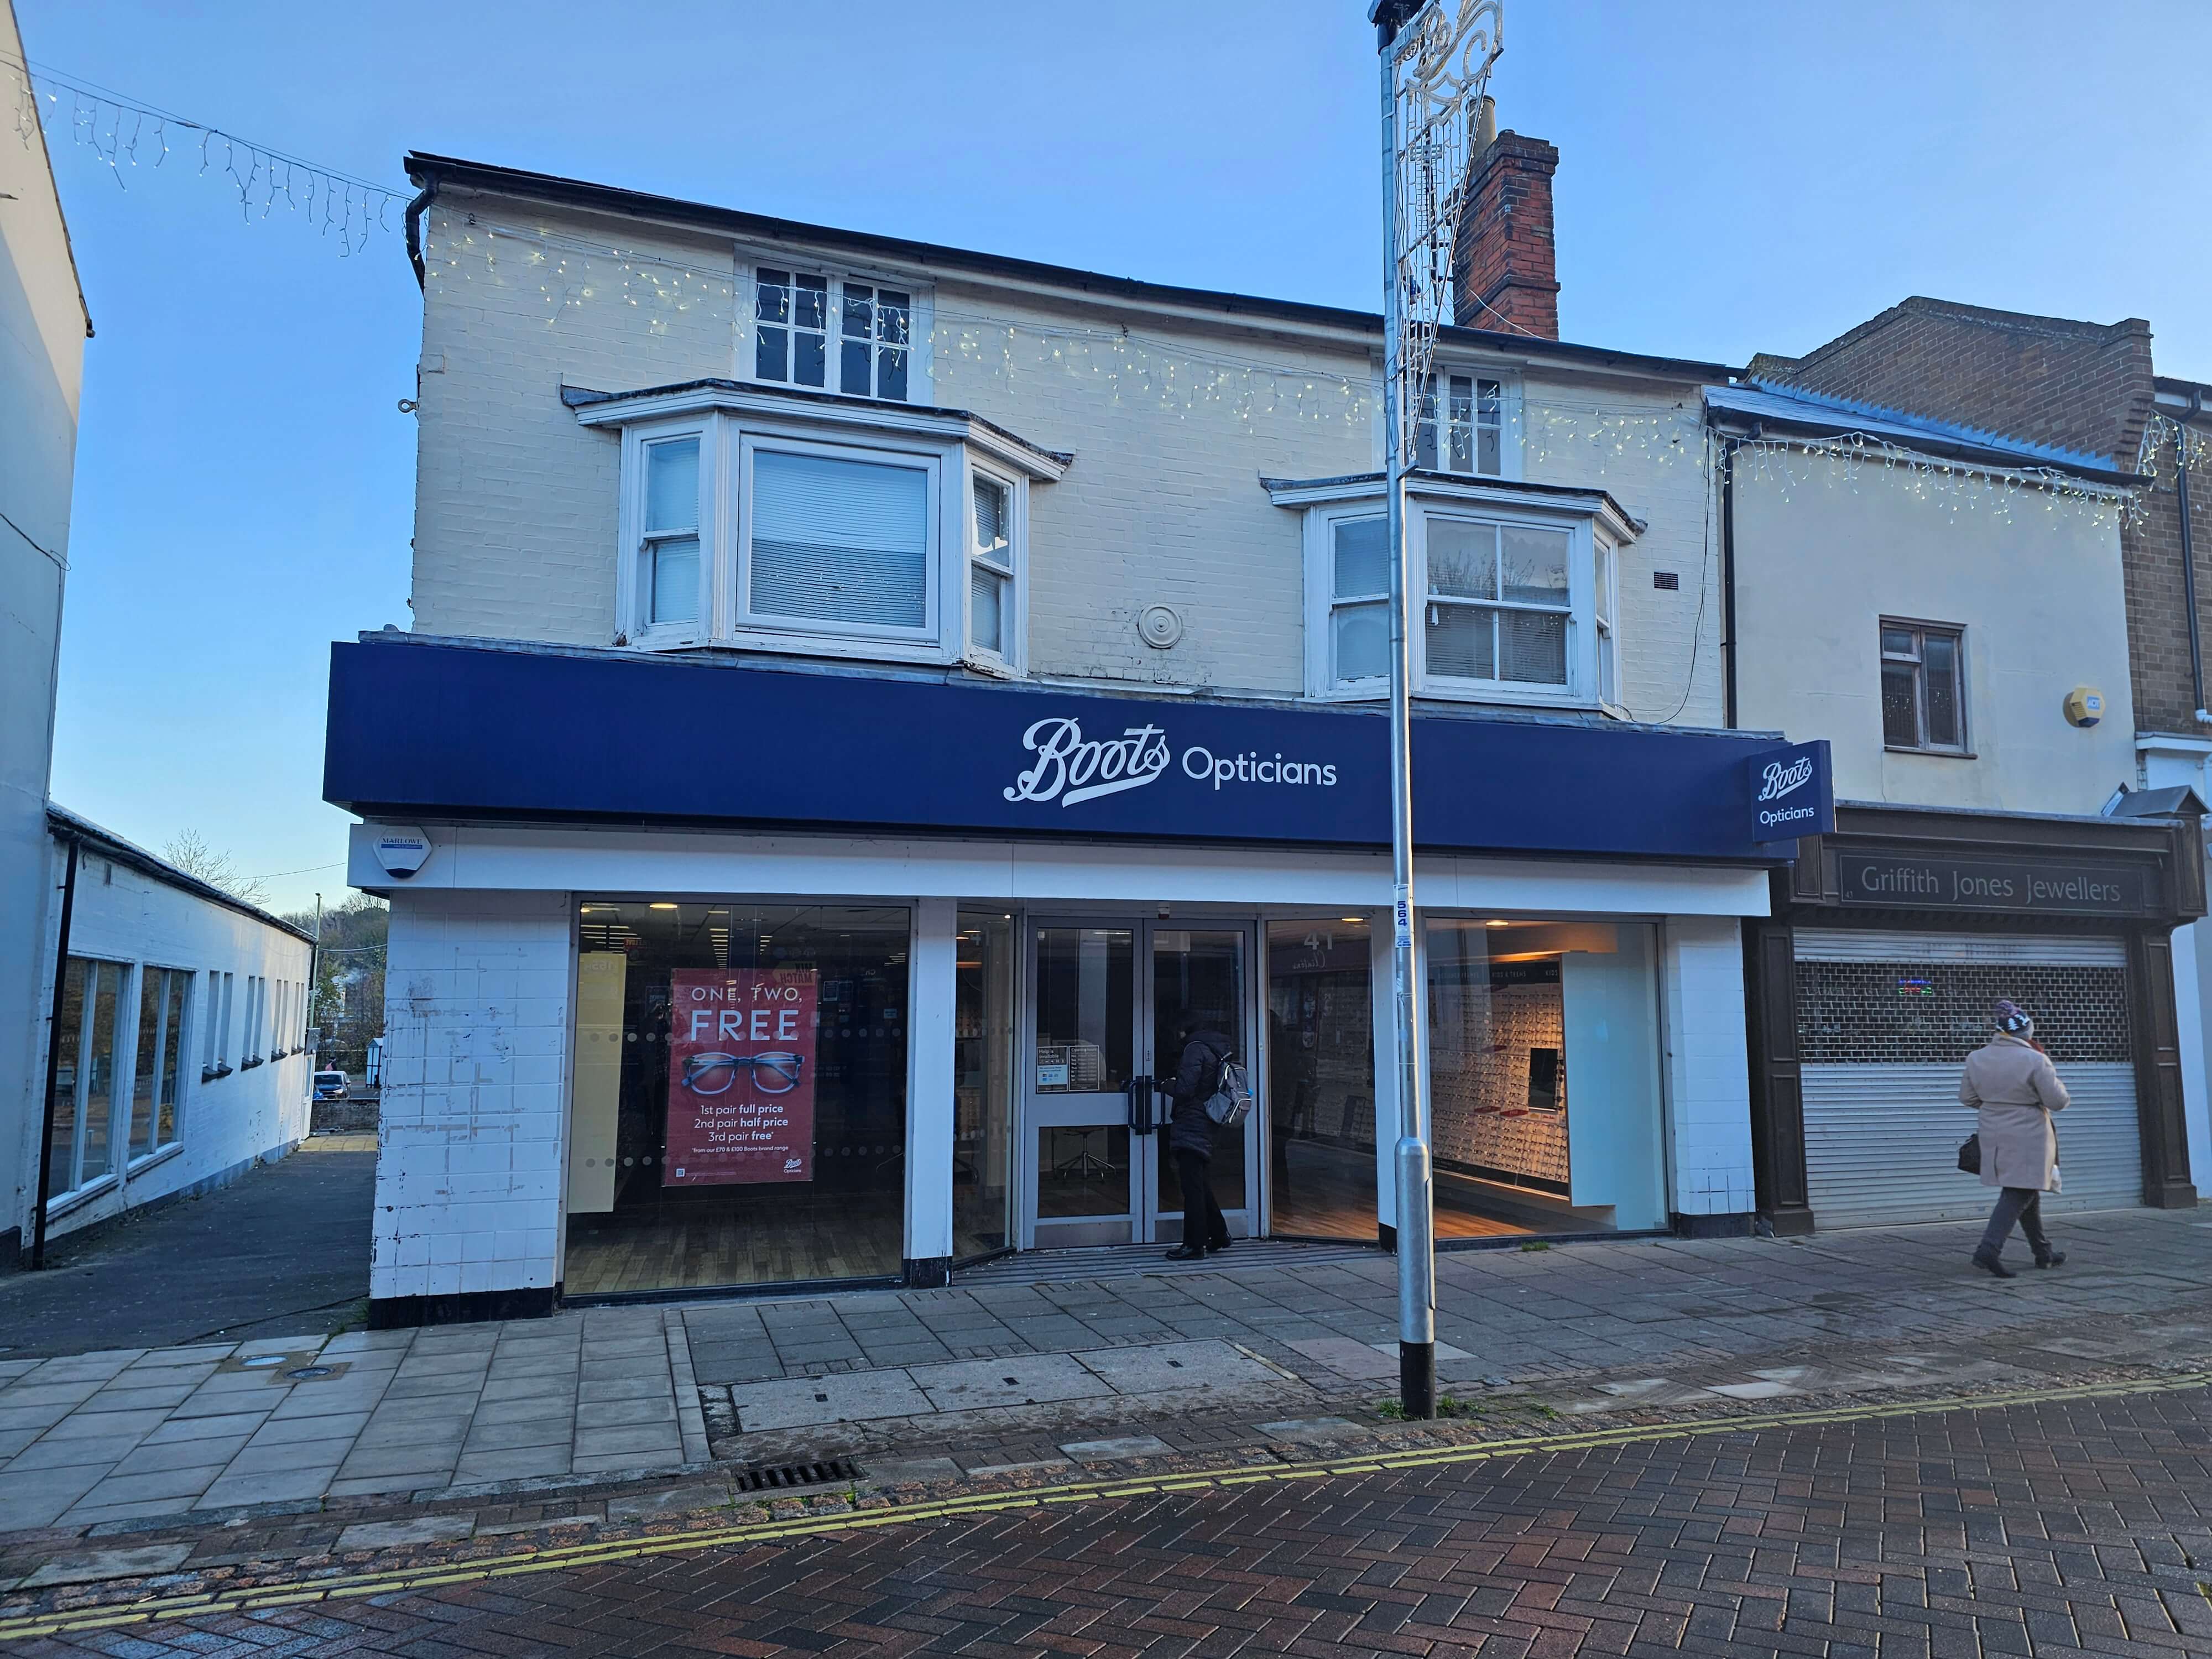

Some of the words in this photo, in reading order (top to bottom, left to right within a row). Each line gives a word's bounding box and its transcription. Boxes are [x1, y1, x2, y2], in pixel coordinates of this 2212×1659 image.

[2088, 700, 2099, 708] ADT
[1003, 717, 1170, 808] Boots
[1182, 747, 1337, 790] Opticians
[1758, 757, 1813, 801] Boots
[1760, 807, 1814, 827] Opticians
[1861, 866, 1939, 894] Griffith
[1953, 870, 2013, 901] Jones
[2026, 874, 2121, 904] Jewellers
[1397, 901, 1407, 926] 564
[1303, 931, 1333, 950] 41
[691, 987, 741, 1002] ONE,
[751, 987, 802, 1003] TWO,
[691, 1010, 799, 1041] FREE
[701, 1105, 713, 1115] 1st
[716, 1105, 737, 1117] pair
[739, 1104, 755, 1114] full
[758, 1104, 783, 1116] price
[694, 1119, 714, 1128] 2nd
[717, 1119, 738, 1130] pair
[740, 1117, 761, 1127] half
[763, 1117, 789, 1129] price
[708, 1132, 726, 1141] 3rd
[728, 1132, 749, 1144] pair
[784, 1159, 802, 1168] Boots
